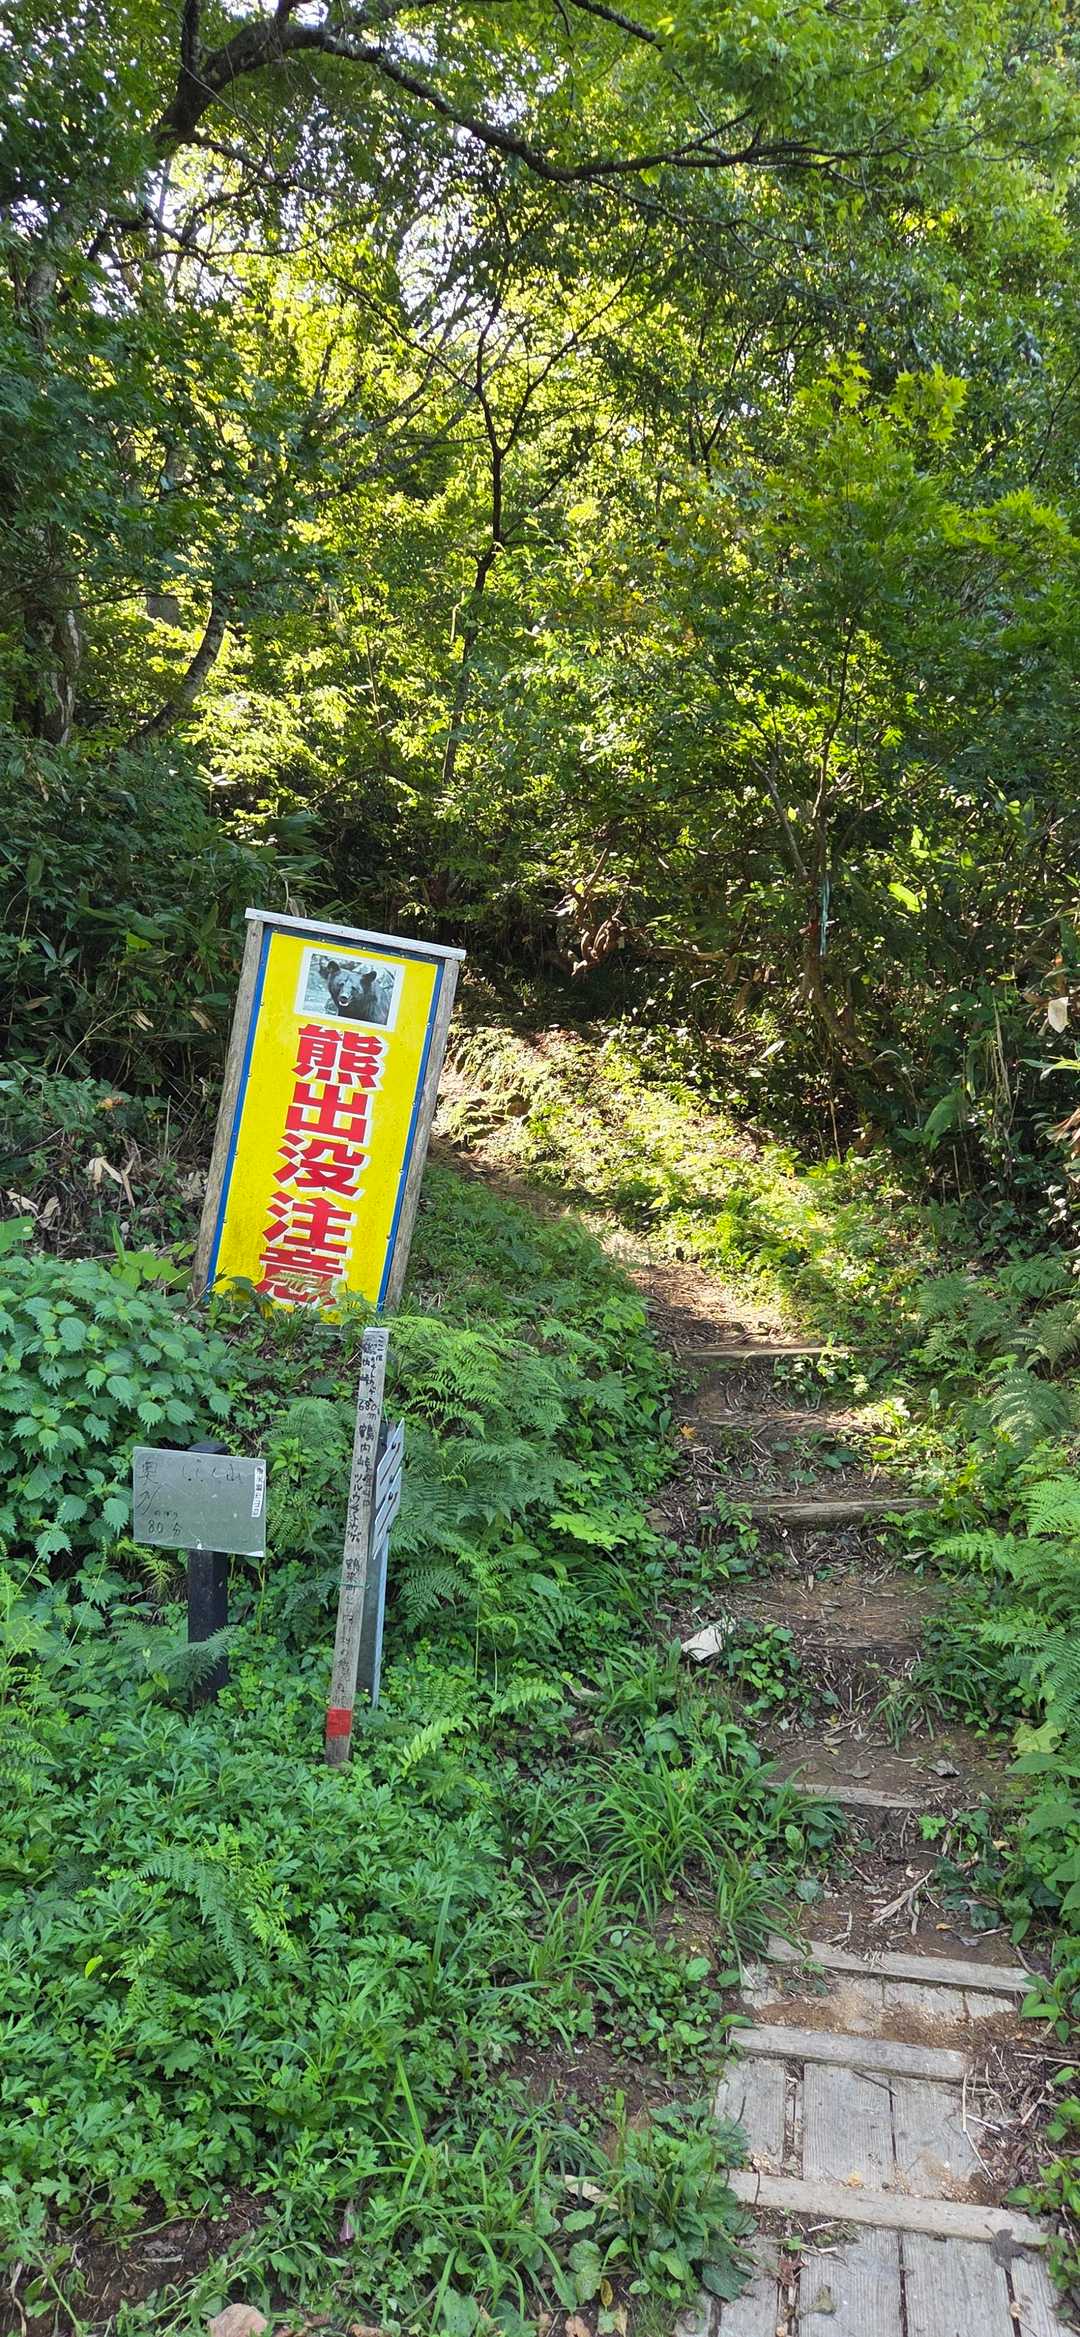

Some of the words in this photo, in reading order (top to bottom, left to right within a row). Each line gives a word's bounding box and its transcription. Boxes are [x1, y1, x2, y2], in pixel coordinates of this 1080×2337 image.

[253, 1023, 384, 1307] 熊出没注意
